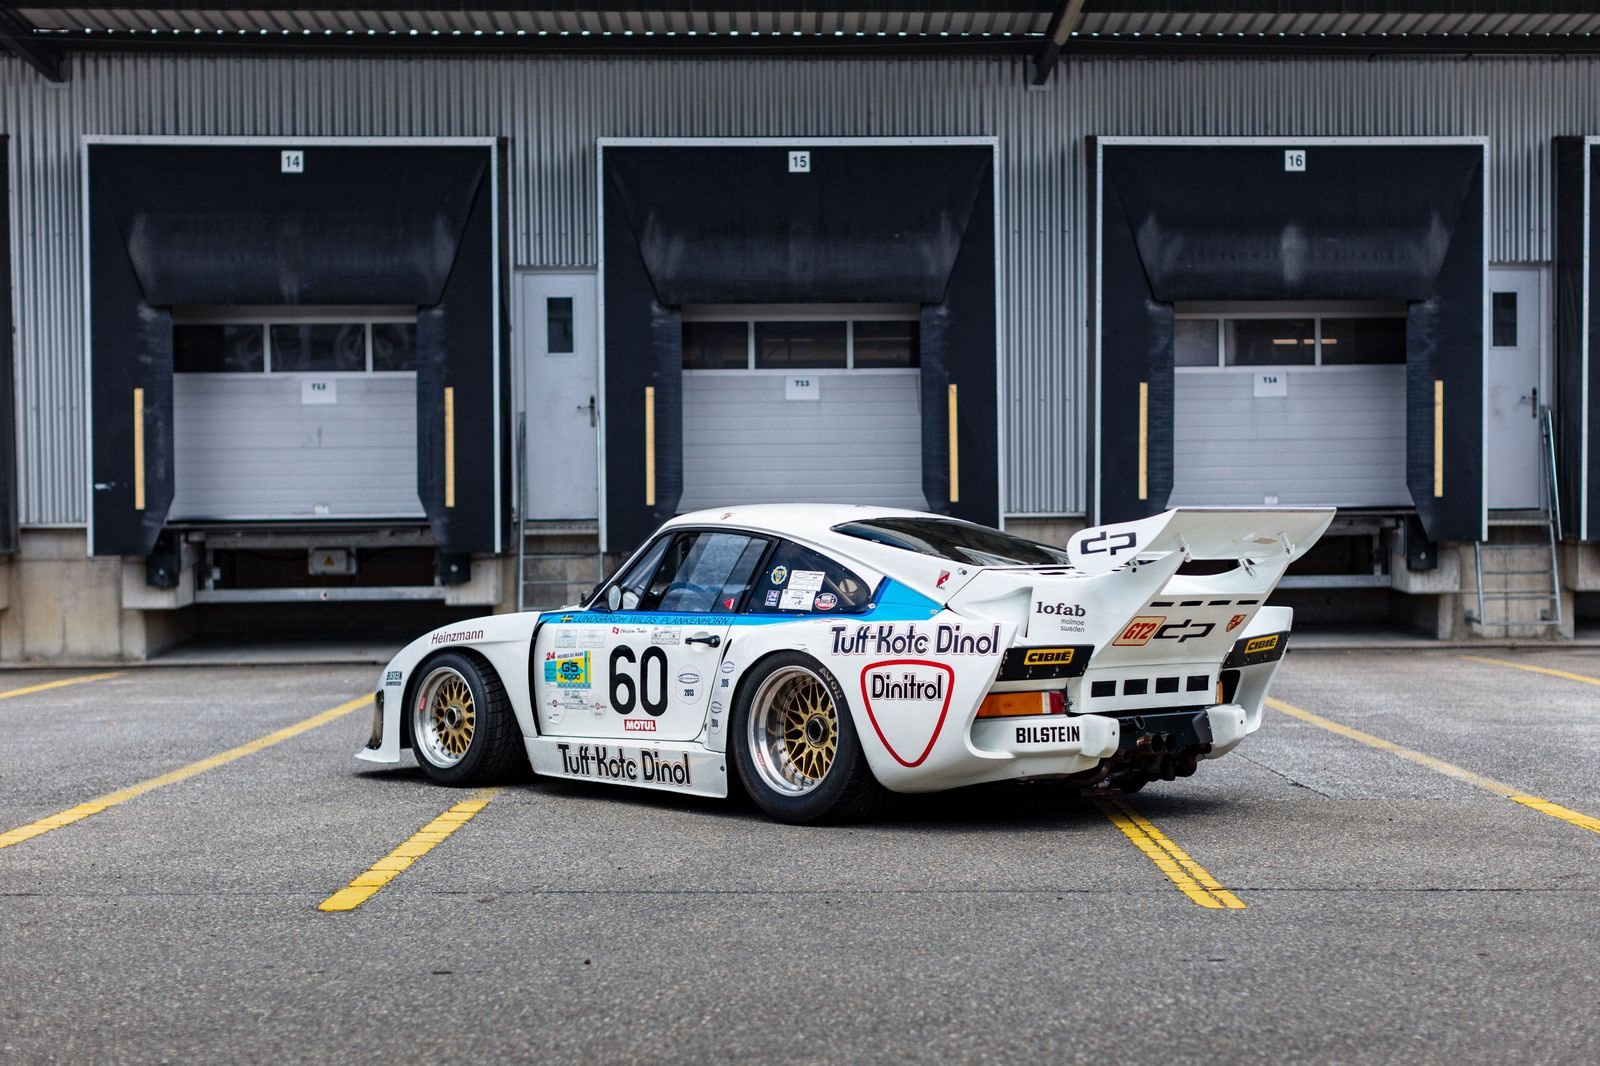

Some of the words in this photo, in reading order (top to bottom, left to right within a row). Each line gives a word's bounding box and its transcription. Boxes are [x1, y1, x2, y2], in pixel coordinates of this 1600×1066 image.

[286, 155, 300, 168] 14
[792, 155, 807, 168] 15
[1289, 154, 1303, 167] 16
[1036, 601, 1086, 617] lofab
[431, 629, 484, 645] Heinzmann
[1060, 625, 1085, 633] sweden
[1122, 622, 1157, 640] GT2
[831, 624, 929, 655] Tuff-Kote
[934, 623, 1001, 655] Dinol
[545, 651, 556, 661] 24
[561, 661, 579, 673] G5
[608, 644, 668, 717] 60
[871, 673, 943, 700] Dinitrol
[625, 720, 656, 731] MOTUL
[1016, 726, 1080, 743] BILSTEIN
[557, 744, 638, 781] Tuff-Kote
[641, 750, 691, 785] Dinol
